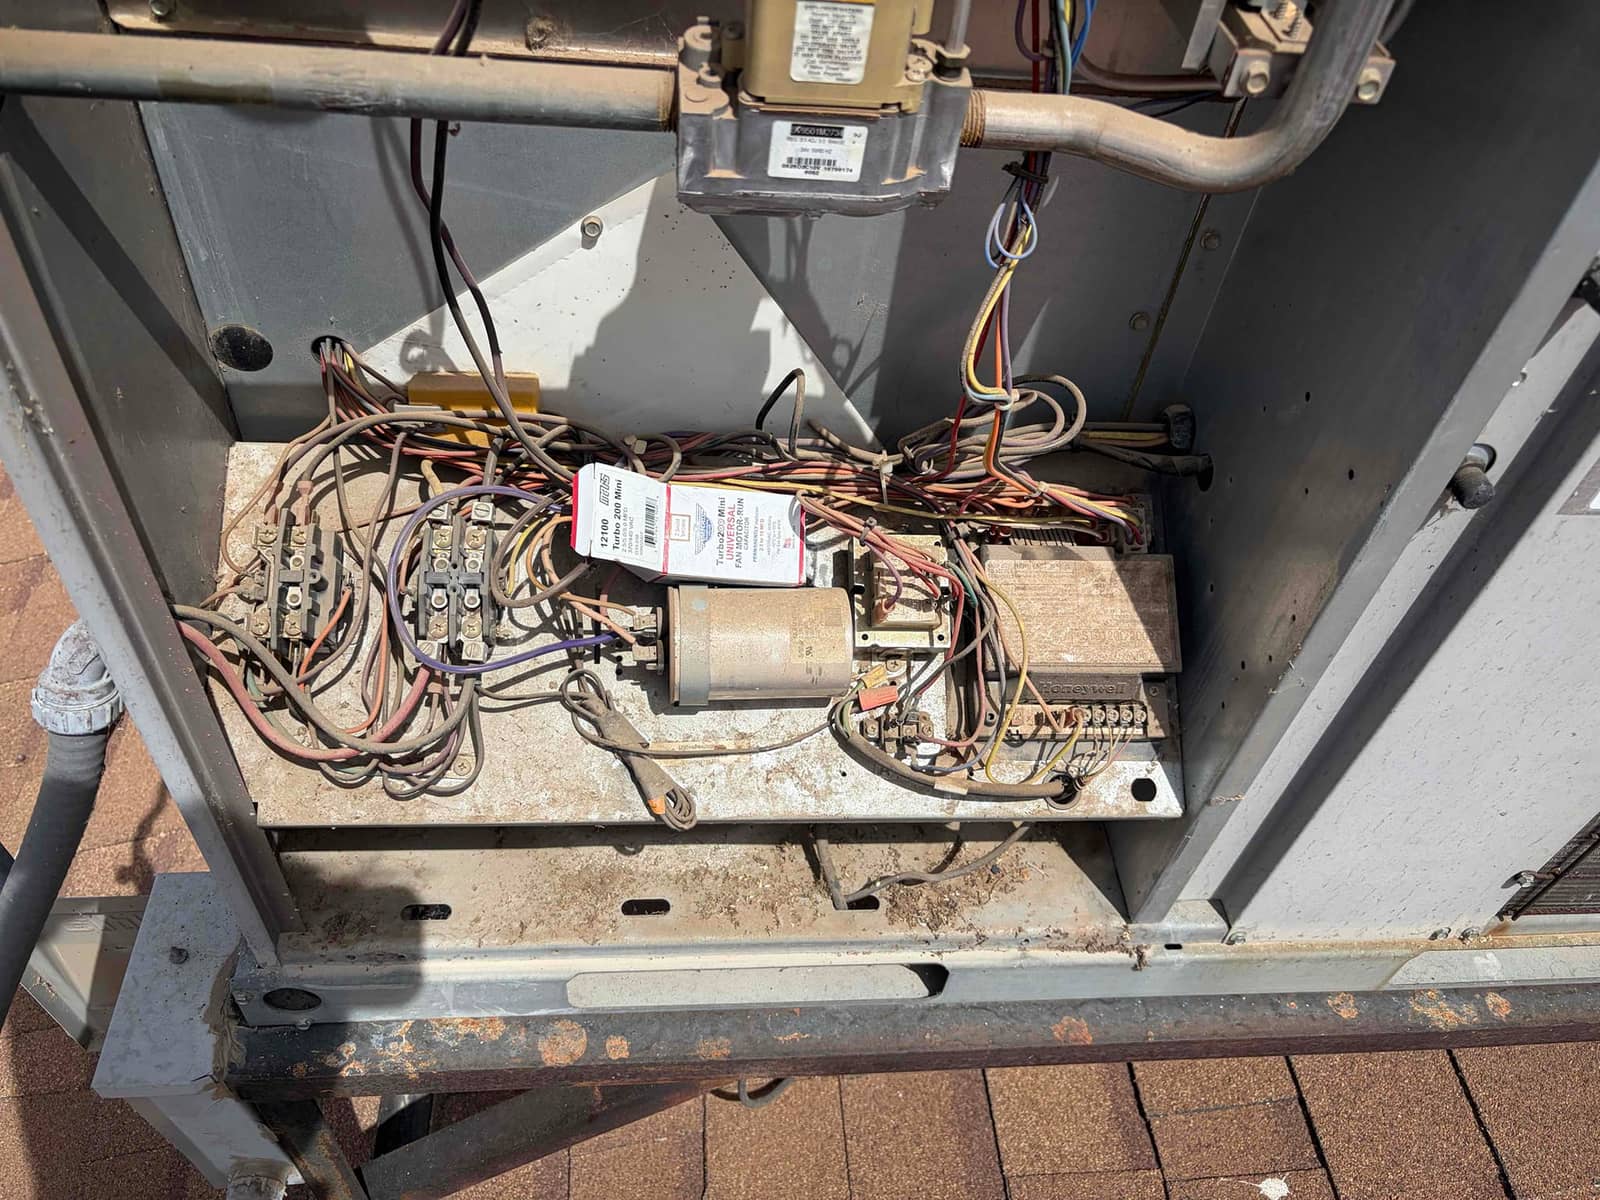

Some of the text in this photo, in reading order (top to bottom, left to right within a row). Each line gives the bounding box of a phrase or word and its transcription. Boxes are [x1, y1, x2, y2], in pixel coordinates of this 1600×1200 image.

[612, 479, 623, 551] Turbo 200 Mini
[717, 496, 726, 518] Mini
[600, 518, 609, 548] 12100
[726, 503, 736, 561] UNIVERSAL
[735, 498, 745, 569] FAN MOTOR-RUN
[1038, 681, 1127, 695] Honeywell
